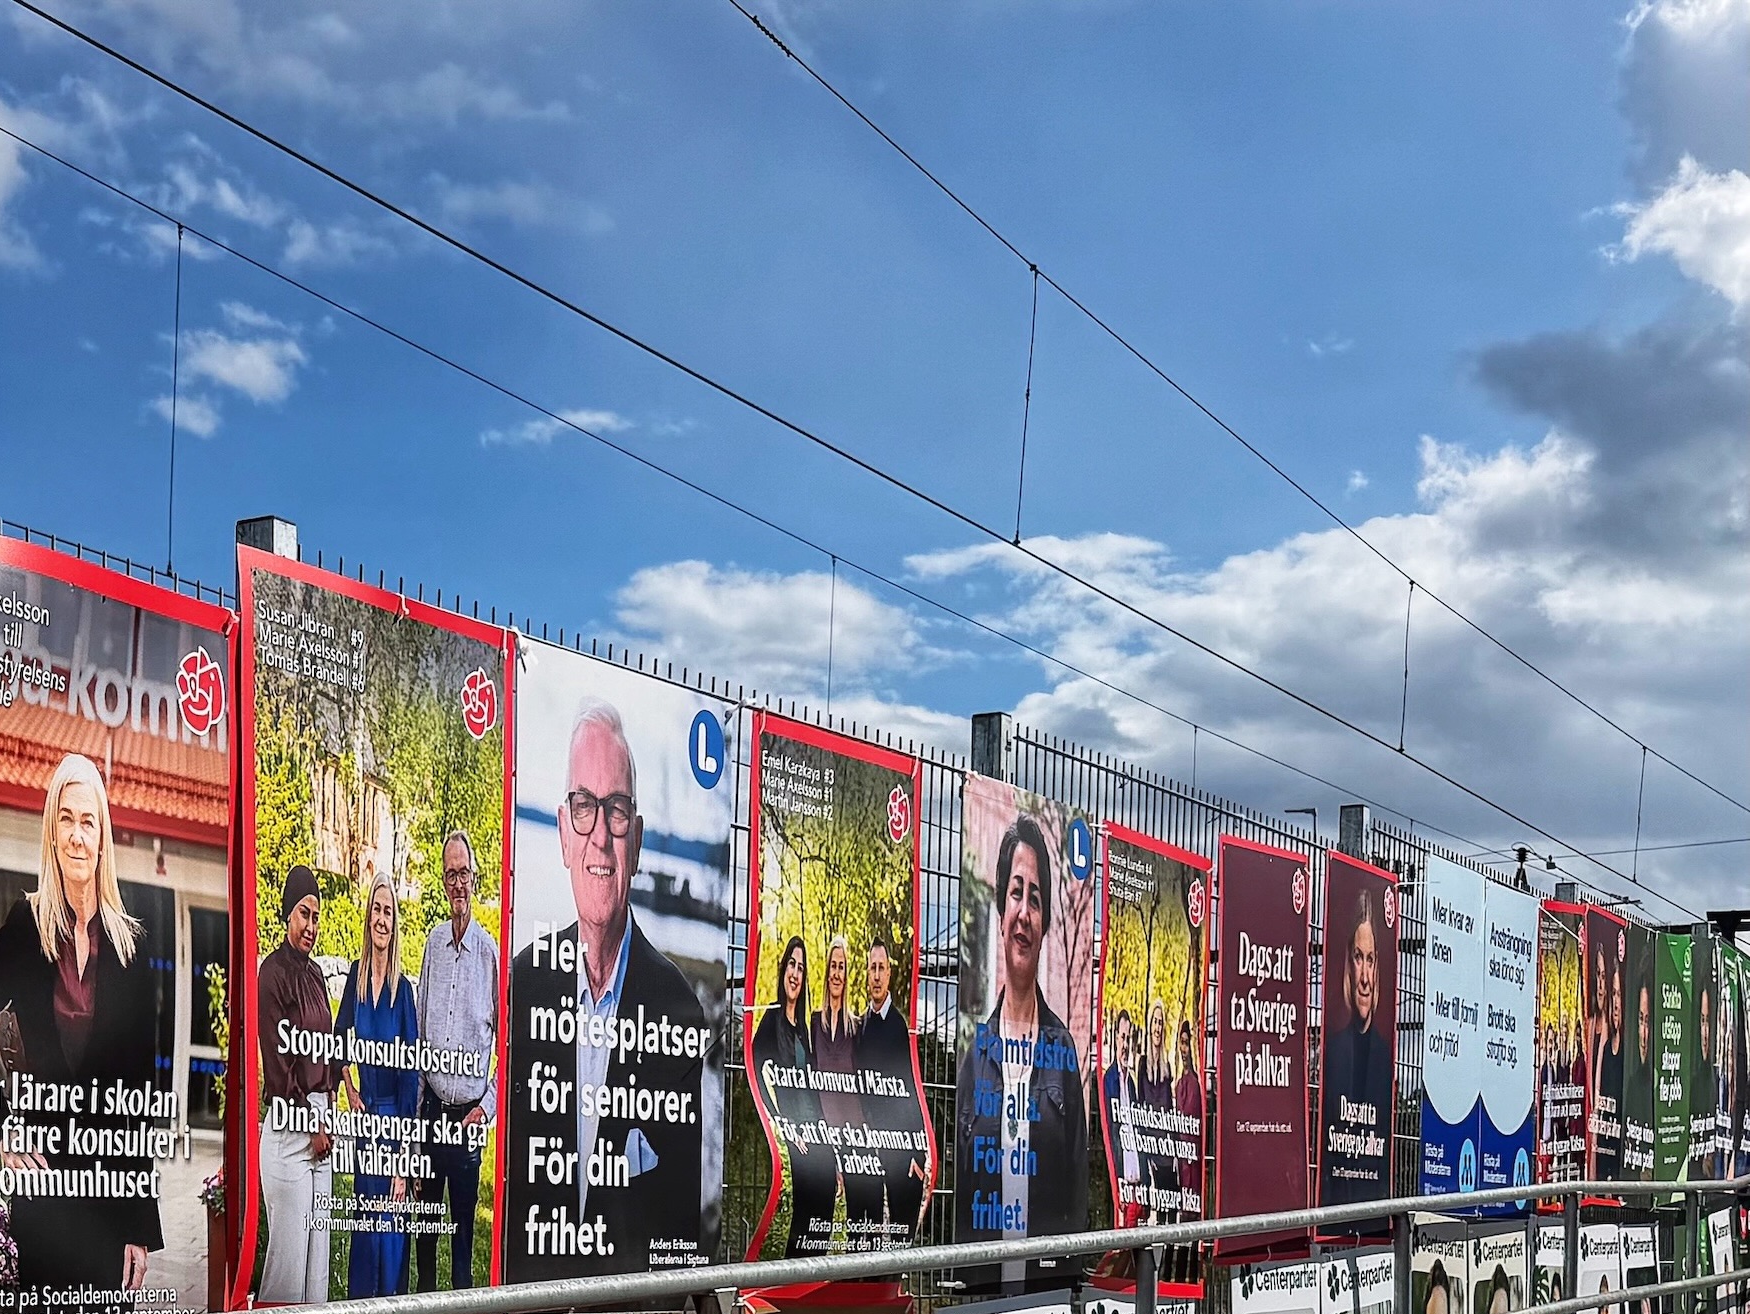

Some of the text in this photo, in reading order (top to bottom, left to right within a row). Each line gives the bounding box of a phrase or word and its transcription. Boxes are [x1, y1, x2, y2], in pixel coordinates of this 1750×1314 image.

[3, 620, 23, 648] till
[258, 600, 365, 648] Susan Jibran #9
[259, 624, 295, 651] Marie
[299, 636, 351, 667] Axelsson
[260, 645, 300, 672] Tomas
[303, 657, 351, 689] Brandell
[532, 920, 588, 974] Fler
[1238, 931, 1294, 988] Dags att
[530, 996, 711, 1064] mötesplatser
[1230, 987, 1297, 1043] ta Sverige
[277, 1019, 484, 1077] Stoppa konsultslöseriet.
[1235, 1042, 1291, 1094] på allvar
[12, 1071, 84, 1113] lärare
[90, 1079, 98, 1114] i
[104, 1079, 178, 1119] skolan
[528, 1062, 696, 1124] för seniorer.
[763, 1059, 910, 1098] Starta komvux i Märsta.
[272, 1096, 488, 1151] Dina skattepengar ska gå
[1007, 1082, 1041, 1123] alla.
[1, 1115, 60, 1155] färre
[68, 1119, 178, 1159] konsulter
[183, 1125, 190, 1159] i
[776, 1117, 928, 1151] För att fler ska komma ut
[332, 1136, 436, 1179] till välfärden.
[528, 1136, 629, 1188] För din
[836, 1148, 886, 1176] i arbete.
[974, 1137, 1037, 1176] För din
[525, 1205, 615, 1257] frihet.
[972, 1190, 1025, 1232] frihet.
[19, 1289, 39, 1314] på
[42, 1284, 177, 1306] Socialdemokraterna
[1256, 1267, 1317, 1295] Centerpartiet
